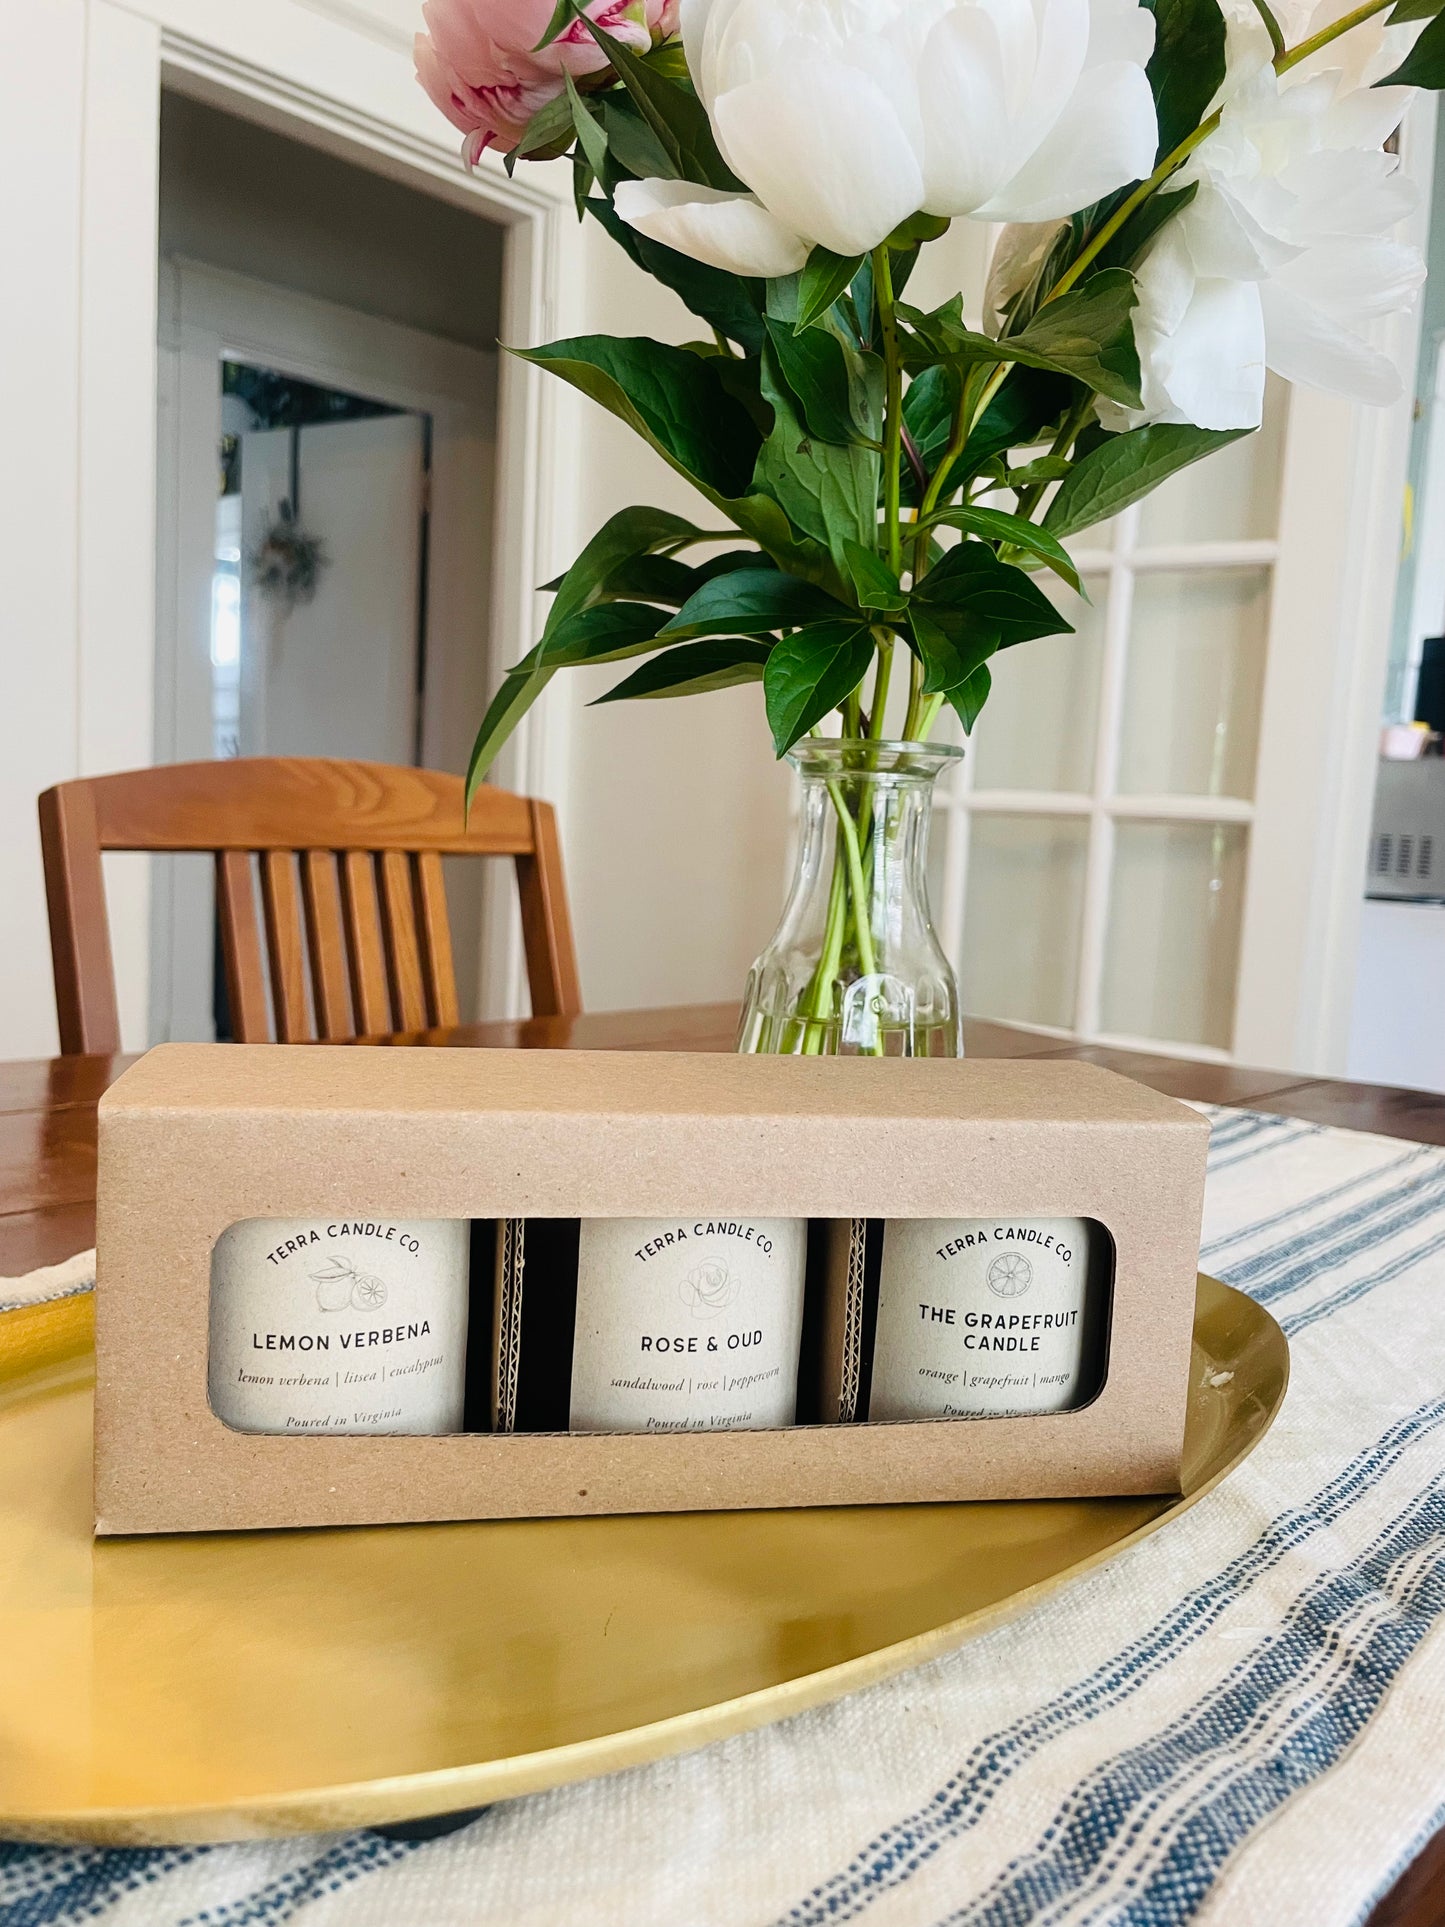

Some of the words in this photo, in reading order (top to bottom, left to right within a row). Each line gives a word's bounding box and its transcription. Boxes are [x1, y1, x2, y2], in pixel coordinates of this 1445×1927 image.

[267, 1230, 320, 1265] TERRA
[327, 1222, 397, 1241] CANDLE
[399, 1234, 420, 1258] CO.
[634, 1228, 688, 1262] TERRA
[694, 1222, 755, 1240] CANDLE
[756, 1234, 773, 1258] CO.
[936, 1231, 988, 1261] TERRA
[994, 1227, 1054, 1248] CANDLE
[1055, 1243, 1072, 1267] CO.
[919, 1304, 956, 1325] THE
[964, 1310, 1078, 1330] GRAPEFRUIT
[253, 1333, 330, 1351] LEMON
[339, 1320, 431, 1349] VERBENA
[641, 1336, 698, 1353] ROSE
[706, 1336, 718, 1352] &
[727, 1330, 763, 1350] OUD
[964, 1335, 1041, 1352] CANDLE
[237, 1367, 274, 1386] lemon
[279, 1369, 330, 1387] verbena
[343, 1370, 377, 1385] litsea
[389, 1354, 444, 1378] eucalyptus
[610, 1376, 685, 1392] sandalwood
[696, 1379, 720, 1391] rose
[728, 1365, 780, 1392] peppercorn
[918, 1366, 959, 1384] orange
[969, 1373, 1030, 1389] grapefruit
[1039, 1372, 1070, 1388] mango
[286, 1415, 331, 1427] Poured
[335, 1415, 347, 1426] in
[354, 1407, 402, 1424] Virginia
[646, 1416, 689, 1430] Poured
[692, 1419, 704, 1428] in
[710, 1411, 752, 1427] Virginia
[943, 1404, 985, 1416] Poured
